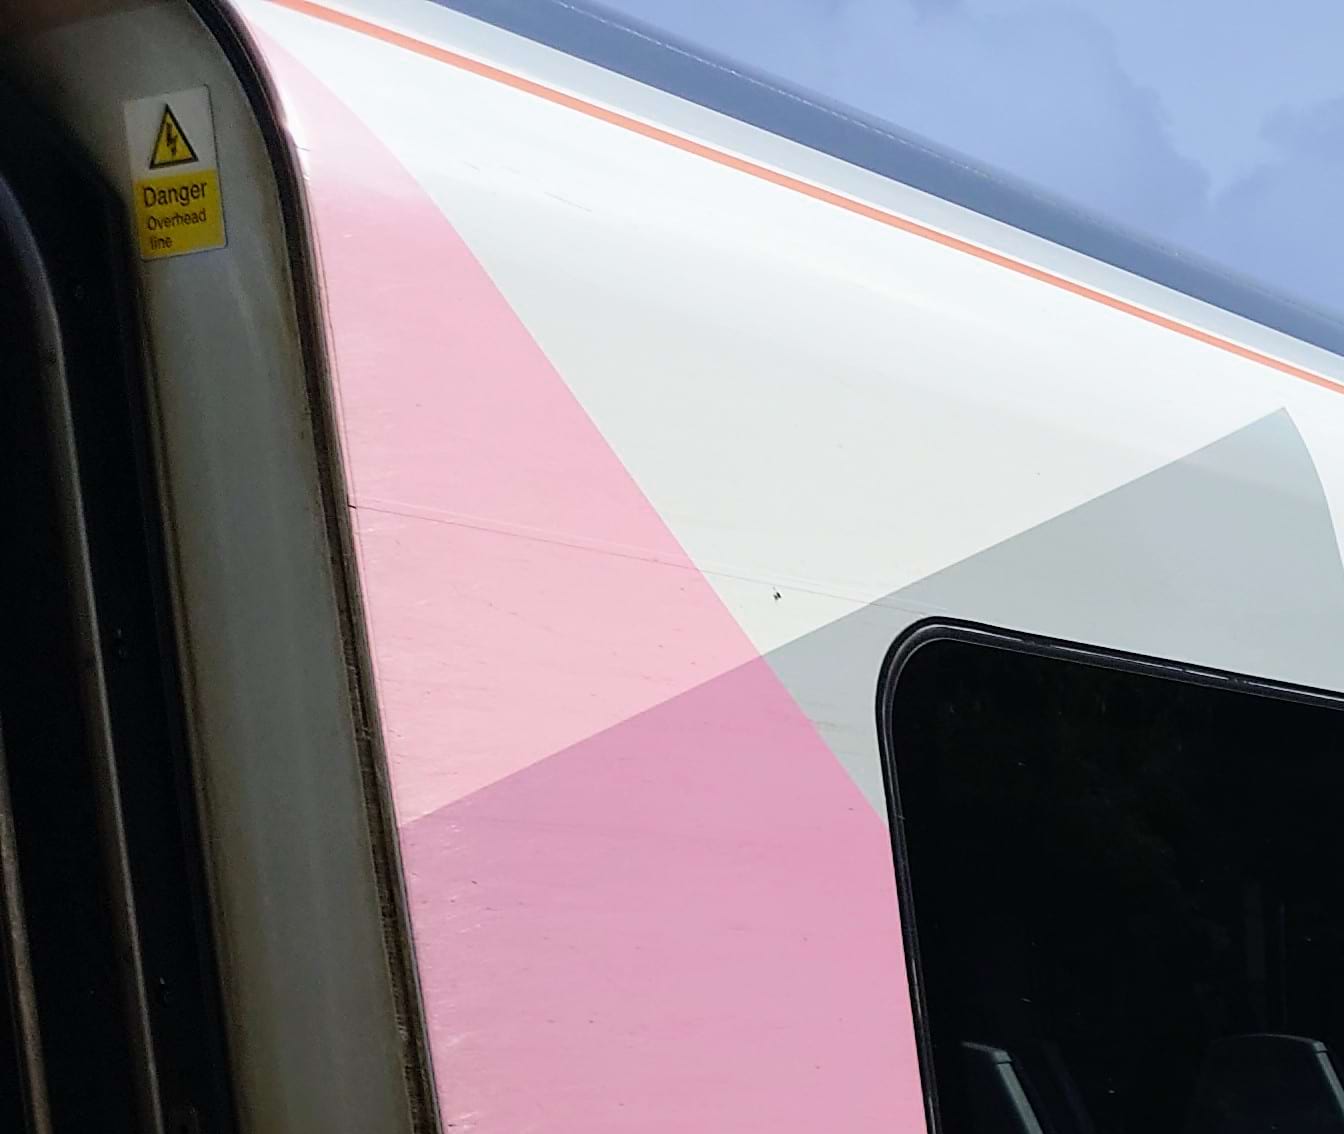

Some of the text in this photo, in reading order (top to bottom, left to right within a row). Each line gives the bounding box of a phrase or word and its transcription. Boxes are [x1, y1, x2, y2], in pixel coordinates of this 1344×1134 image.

[144, 182, 207, 208] Danger
[147, 208, 207, 231] Overhead
[150, 235, 173, 250] line
